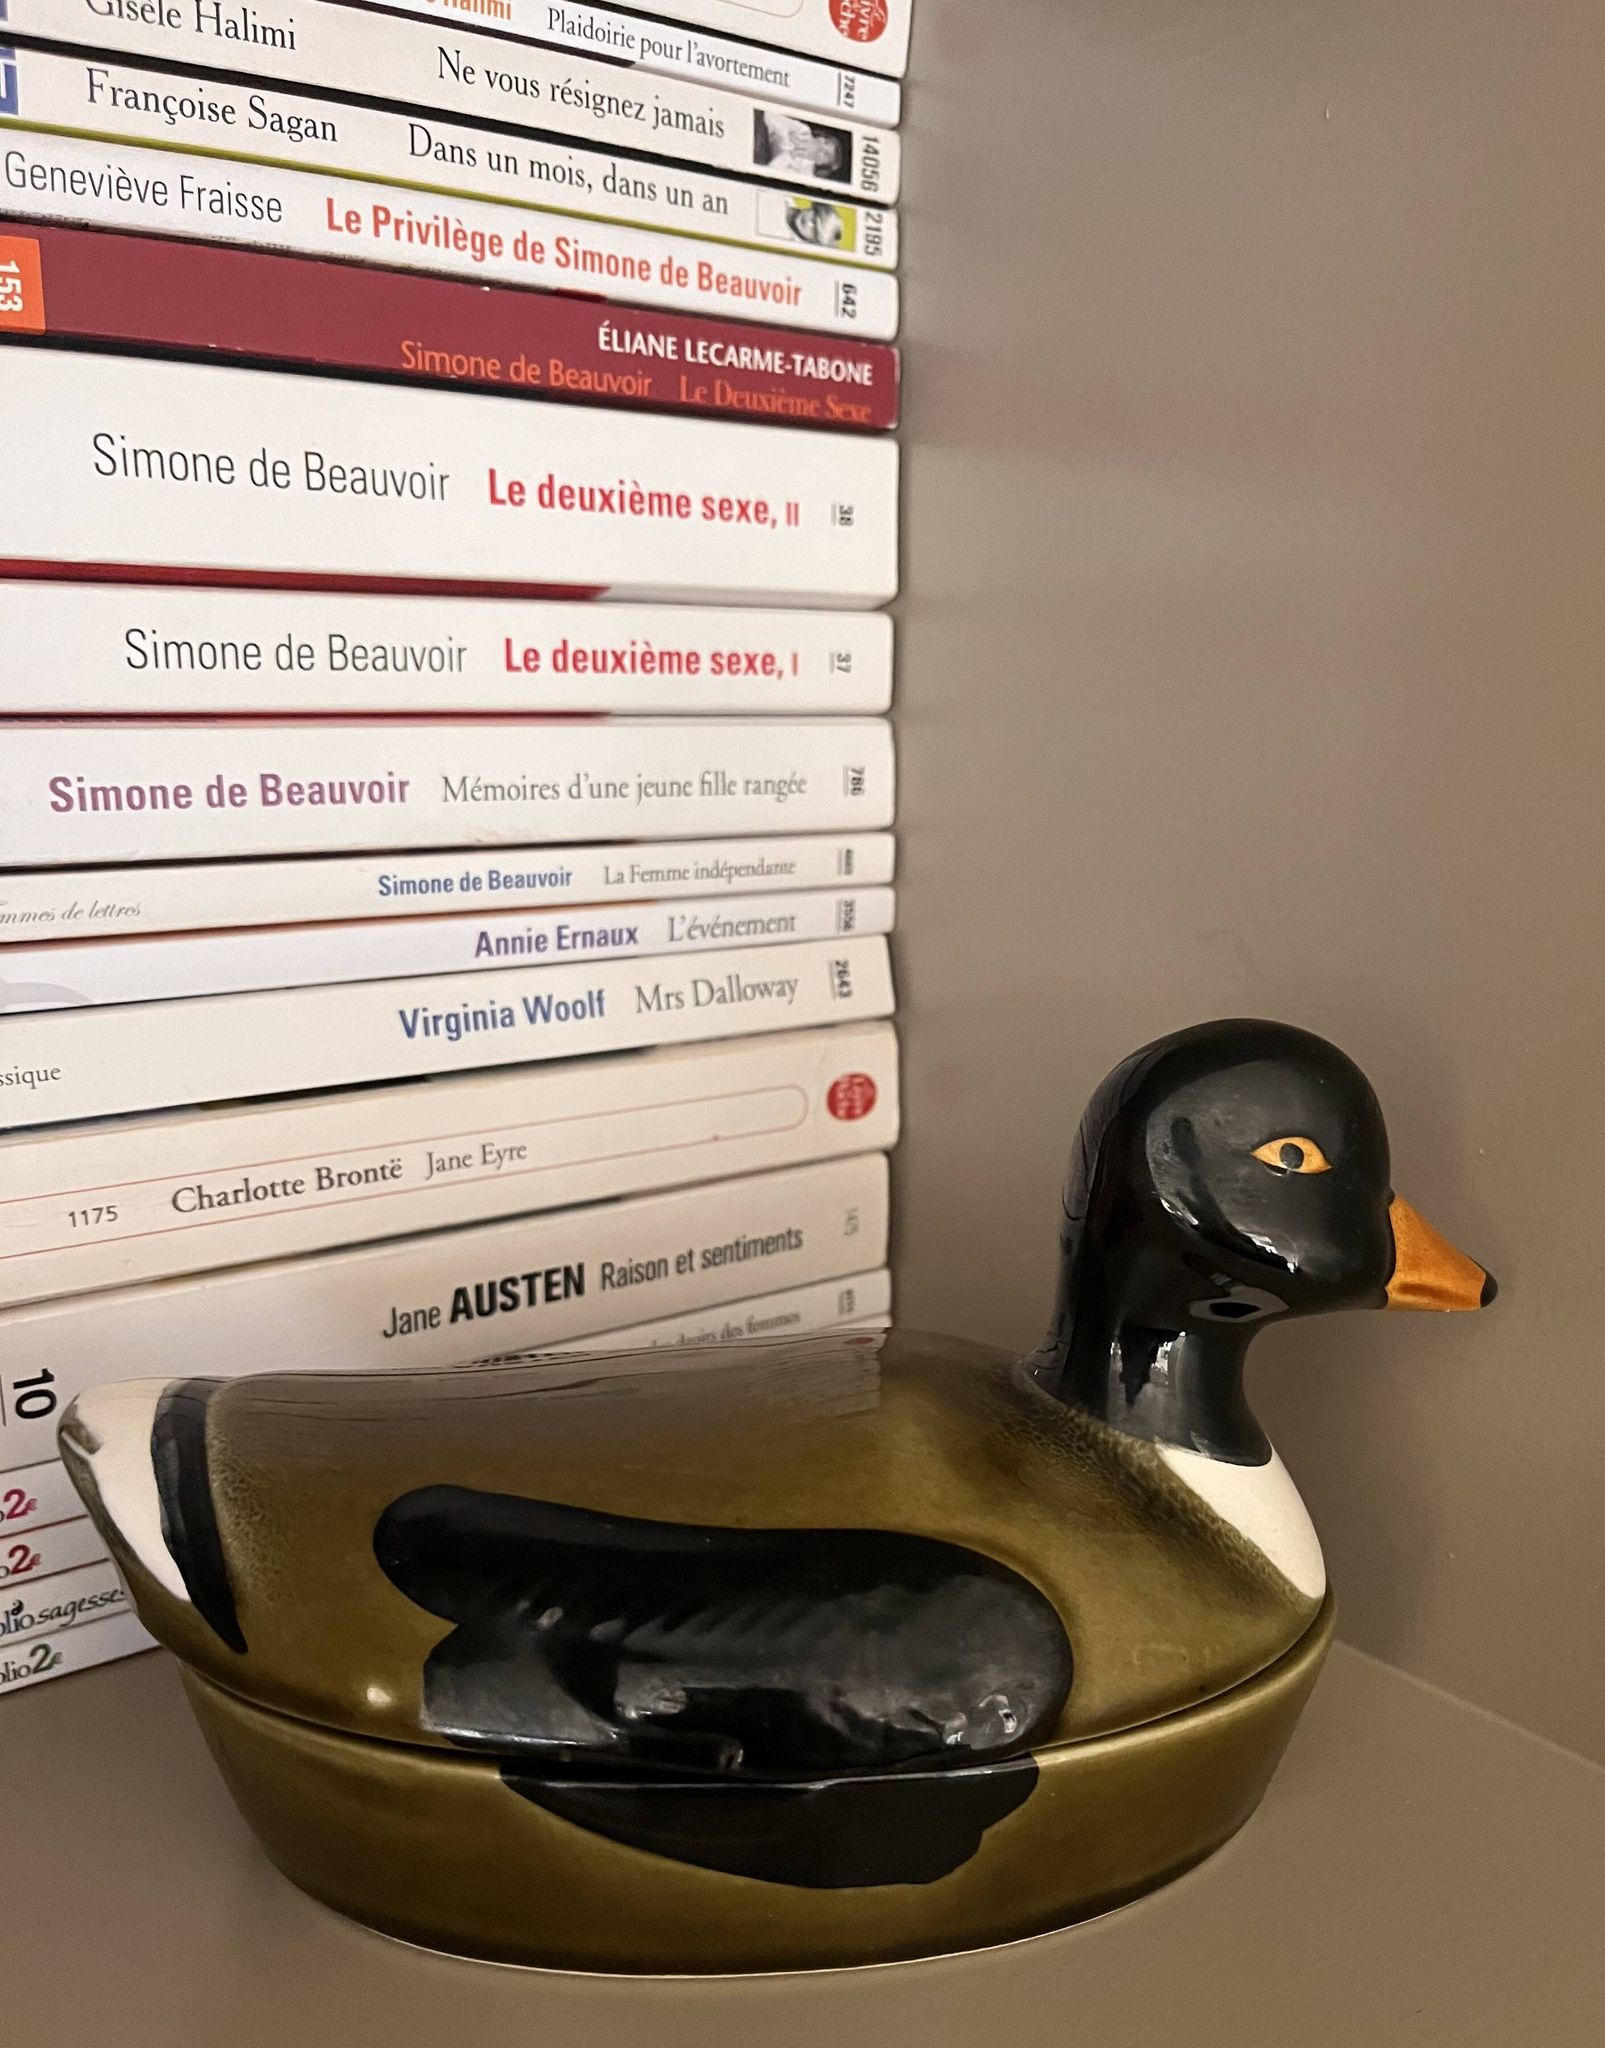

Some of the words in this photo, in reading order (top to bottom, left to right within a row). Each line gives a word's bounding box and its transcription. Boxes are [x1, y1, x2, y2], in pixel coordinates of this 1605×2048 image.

[548, 8, 635, 49] Plaidoirie
[639, 37, 684, 63] pour
[196, 0, 296, 50] Halimi
[438, 46, 476, 84] Ne
[484, 68, 540, 98] vous
[549, 78, 646, 121] résignez
[651, 94, 725, 138] jamais
[86, 67, 237, 125] Françoise
[247, 96, 338, 142] Sagan
[408, 123, 477, 167] Dans
[487, 154, 519, 174] un
[529, 156, 593, 193] mois,
[602, 163, 657, 202] dans
[666, 187, 695, 208] un
[702, 193, 729, 214] an
[861, 135, 881, 193] 14056
[5, 151, 168, 206] Geneviève
[180, 175, 282, 222] Fraisse
[327, 198, 362, 234] Le
[373, 205, 504, 262] Privilège
[513, 232, 545, 263] de
[555, 236, 651, 282] Simone
[660, 259, 689, 288] de
[697, 262, 802, 306] Beauvoir
[401, 340, 501, 379] Simone
[509, 354, 541, 384] de
[549, 359, 652, 397] Beauvoir
[679, 375, 708, 403] Le
[598, 321, 677, 360] ÉLIANE
[685, 338, 873, 386] LECARME-TABONE
[92, 432, 235, 485] Simone
[249, 447, 291, 489] de
[304, 451, 450, 500] Beauvoir
[488, 468, 526, 506] Le
[537, 474, 692, 519] deuxième
[701, 496, 779, 530] sexe,
[125, 628, 262, 671] Simone
[275, 633, 315, 671] de
[329, 634, 467, 673] Beauvoir
[504, 637, 541, 673] Le
[552, 640, 701, 676] deuxième
[710, 648, 784, 680] sexe,
[49, 776, 193, 813] Simone
[206, 775, 248, 810] de
[260, 771, 410, 807] Beauvoir
[442, 775, 560, 803] Mémoires
[636, 774, 695, 806] jeune
[700, 771, 737, 797] fille
[744, 773, 807, 803] rangée
[61, 902, 84, 920] de
[89, 900, 141, 918] lettres
[379, 874, 454, 897] Simone
[460, 871, 483, 892] de
[488, 867, 572, 891] Beauvoir
[603, 866, 625, 885] La
[630, 862, 690, 883] Femme
[475, 929, 549, 958] Annie
[557, 925, 639, 951] Ernaux
[400, 1000, 515, 1041] Virginia
[522, 989, 605, 1024] Woolf
[635, 983, 688, 1014] Mrs
[694, 974, 799, 1012] Dalloway
[68, 1205, 119, 1228] 1175
[171, 1175, 306, 1213] Charlotte
[315, 1158, 403, 1192] Brontë
[425, 1150, 474, 1179] Jane
[480, 1142, 528, 1167] Eyre
[383, 1304, 441, 1339] Jane
[449, 1262, 586, 1324] AUSTEN
[600, 1258, 668, 1291] Raison
[675, 1250, 696, 1273] et
[701, 1226, 804, 1268] sentiments
[12, 1368, 57, 1419] 10
